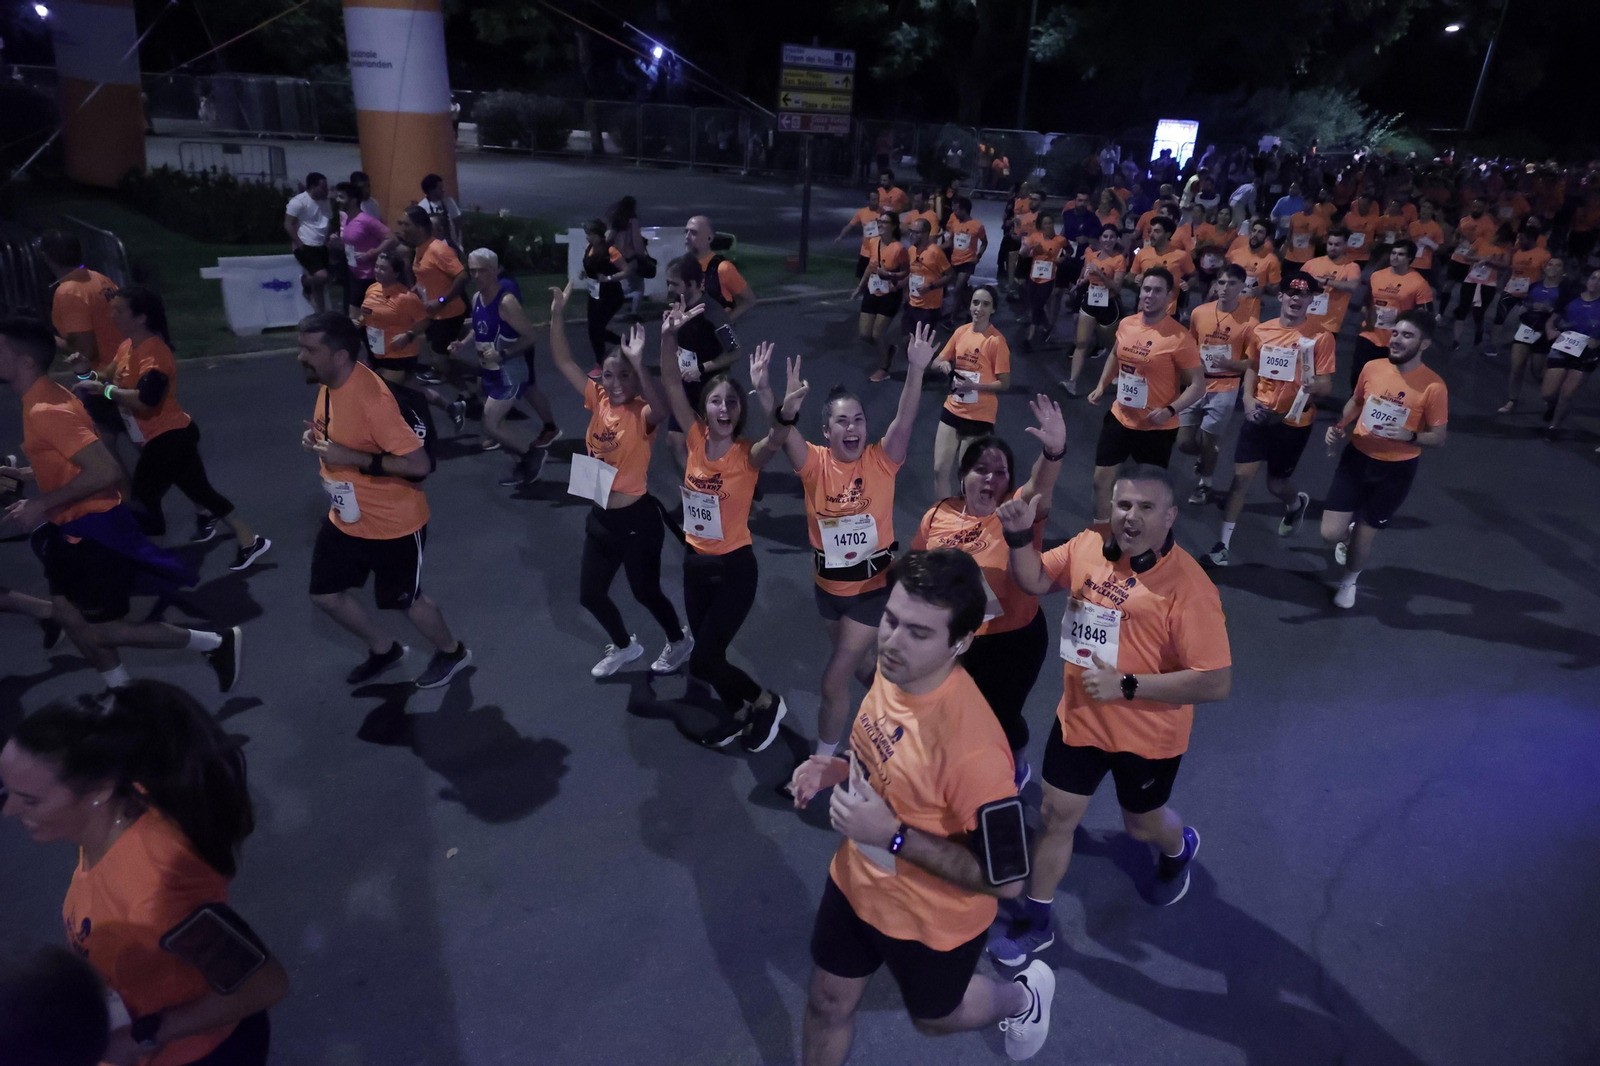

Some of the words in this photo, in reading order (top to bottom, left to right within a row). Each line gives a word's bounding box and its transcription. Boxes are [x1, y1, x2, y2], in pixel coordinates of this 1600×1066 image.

[1266, 356, 1288, 367] 20502
[1122, 384, 1138, 395] 3945
[688, 506, 712, 521] 15168
[834, 532, 867, 546] 14702
[1109, 594, 1125, 606] KH7
[1071, 621, 1107, 644] 21848
